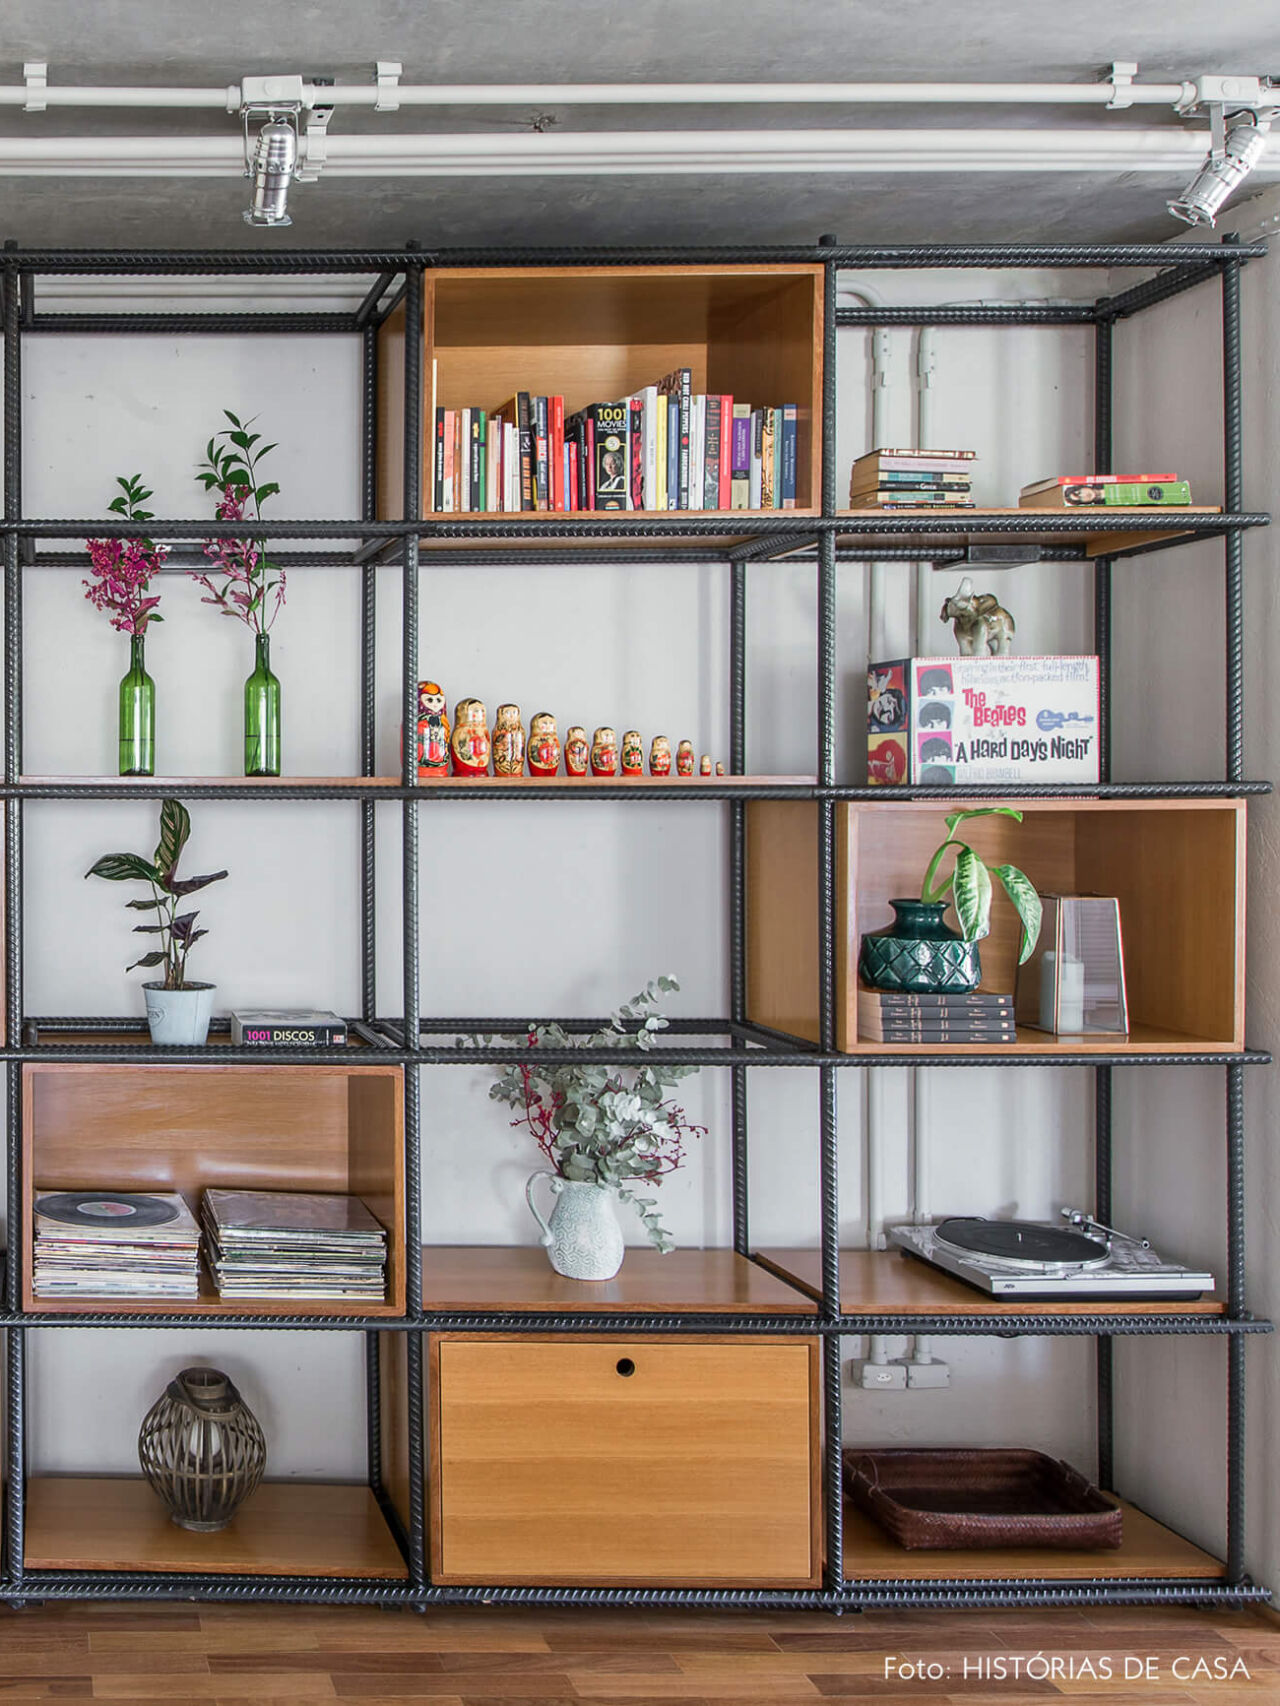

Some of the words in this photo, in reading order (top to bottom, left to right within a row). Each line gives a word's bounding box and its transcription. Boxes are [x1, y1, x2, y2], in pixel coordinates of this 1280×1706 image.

[682, 372, 691, 383] RED
[597, 408, 626, 421] 1001
[597, 420, 626, 428] MOVIES
[681, 411, 690, 434] PEPPERS
[962, 688, 986, 708] The
[247, 1030, 271, 1041] 1001
[273, 1030, 315, 1041] DISCOS
